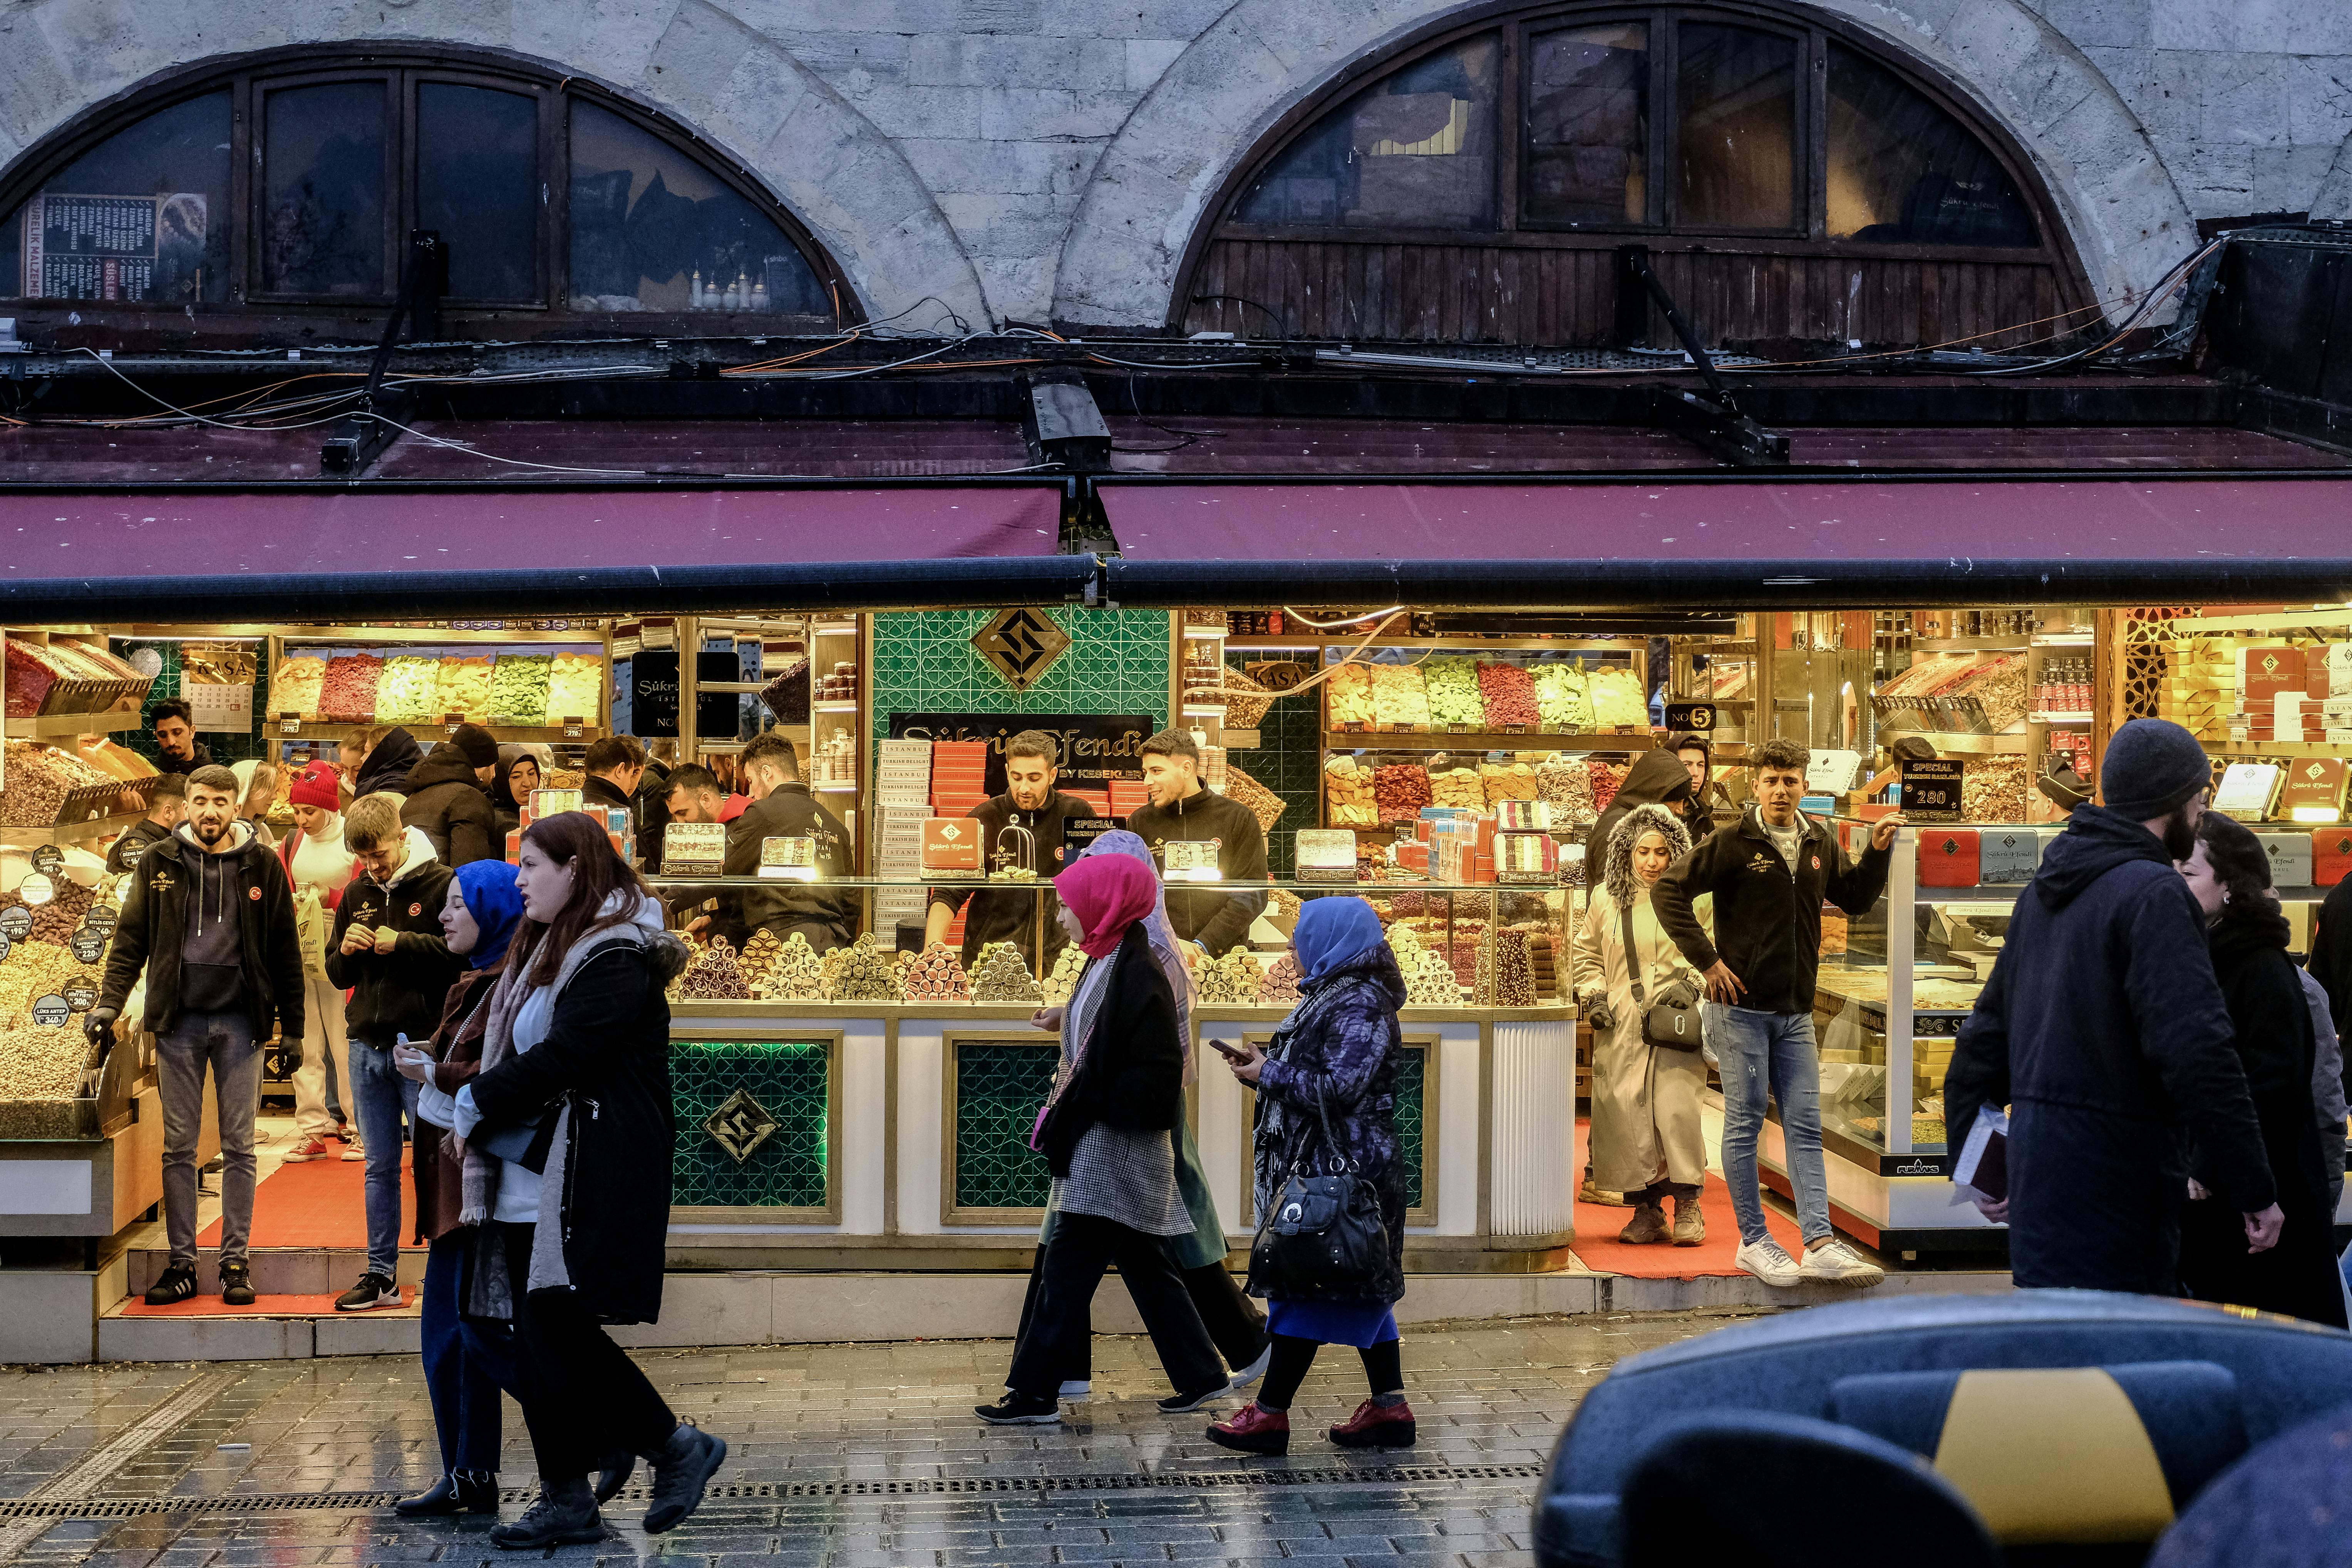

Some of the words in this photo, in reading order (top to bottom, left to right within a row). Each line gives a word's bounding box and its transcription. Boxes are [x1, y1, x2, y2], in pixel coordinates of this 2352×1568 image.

[197, 661, 248, 675] KASA
[1253, 672, 1302, 686] KASA
[1672, 713, 1689, 722] NO
[1694, 709, 1707, 725] 5
[657, 719, 674, 727] NO
[1913, 763, 1953, 772] SPECIAL
[1059, 770, 1073, 778] BY
[1078, 770, 1143, 779] KESEKLER
[1917, 791, 1946, 804] 280
[1074, 820, 1116, 829] SPECIAL
[2010, 850, 2032, 859] Efendi
